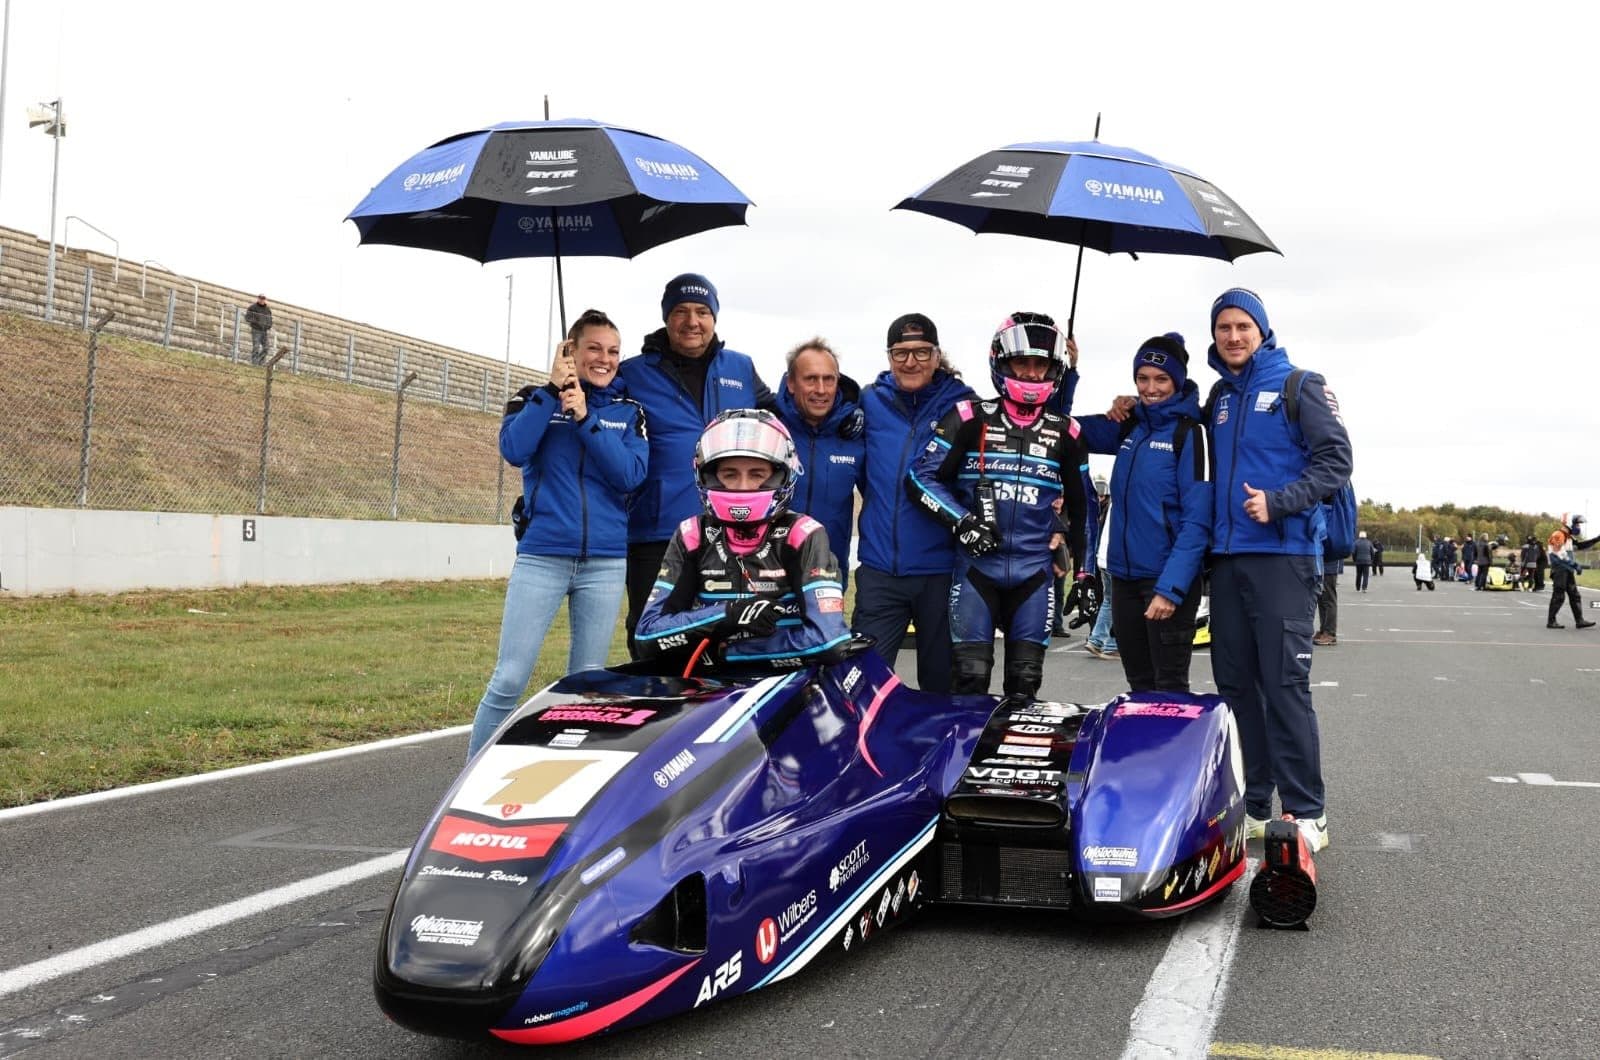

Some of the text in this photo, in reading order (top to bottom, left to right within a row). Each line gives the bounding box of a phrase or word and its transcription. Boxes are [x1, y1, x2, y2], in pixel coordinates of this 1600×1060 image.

[419, 163, 465, 185] YAMAHA
[648, 160, 699, 177] YAMAHA
[1103, 182, 1164, 201] YAMAHA
[965, 458, 1033, 472] Stenhausen
[245, 521, 254, 539] 5
[660, 748, 697, 781] YAMAHA
[968, 766, 1062, 781] VOGT
[483, 759, 603, 806] 1
[988, 778, 1060, 787] engineering
[450, 833, 529, 850] MOTUL
[838, 839, 867, 876] SCOTT
[418, 865, 529, 886] Steinhausen Racing
[839, 851, 870, 887] PROPERTIES
[777, 889, 817, 934] Wilbers
[694, 949, 743, 1009] ARS
[524, 1000, 589, 1025] rubbermagazijn
